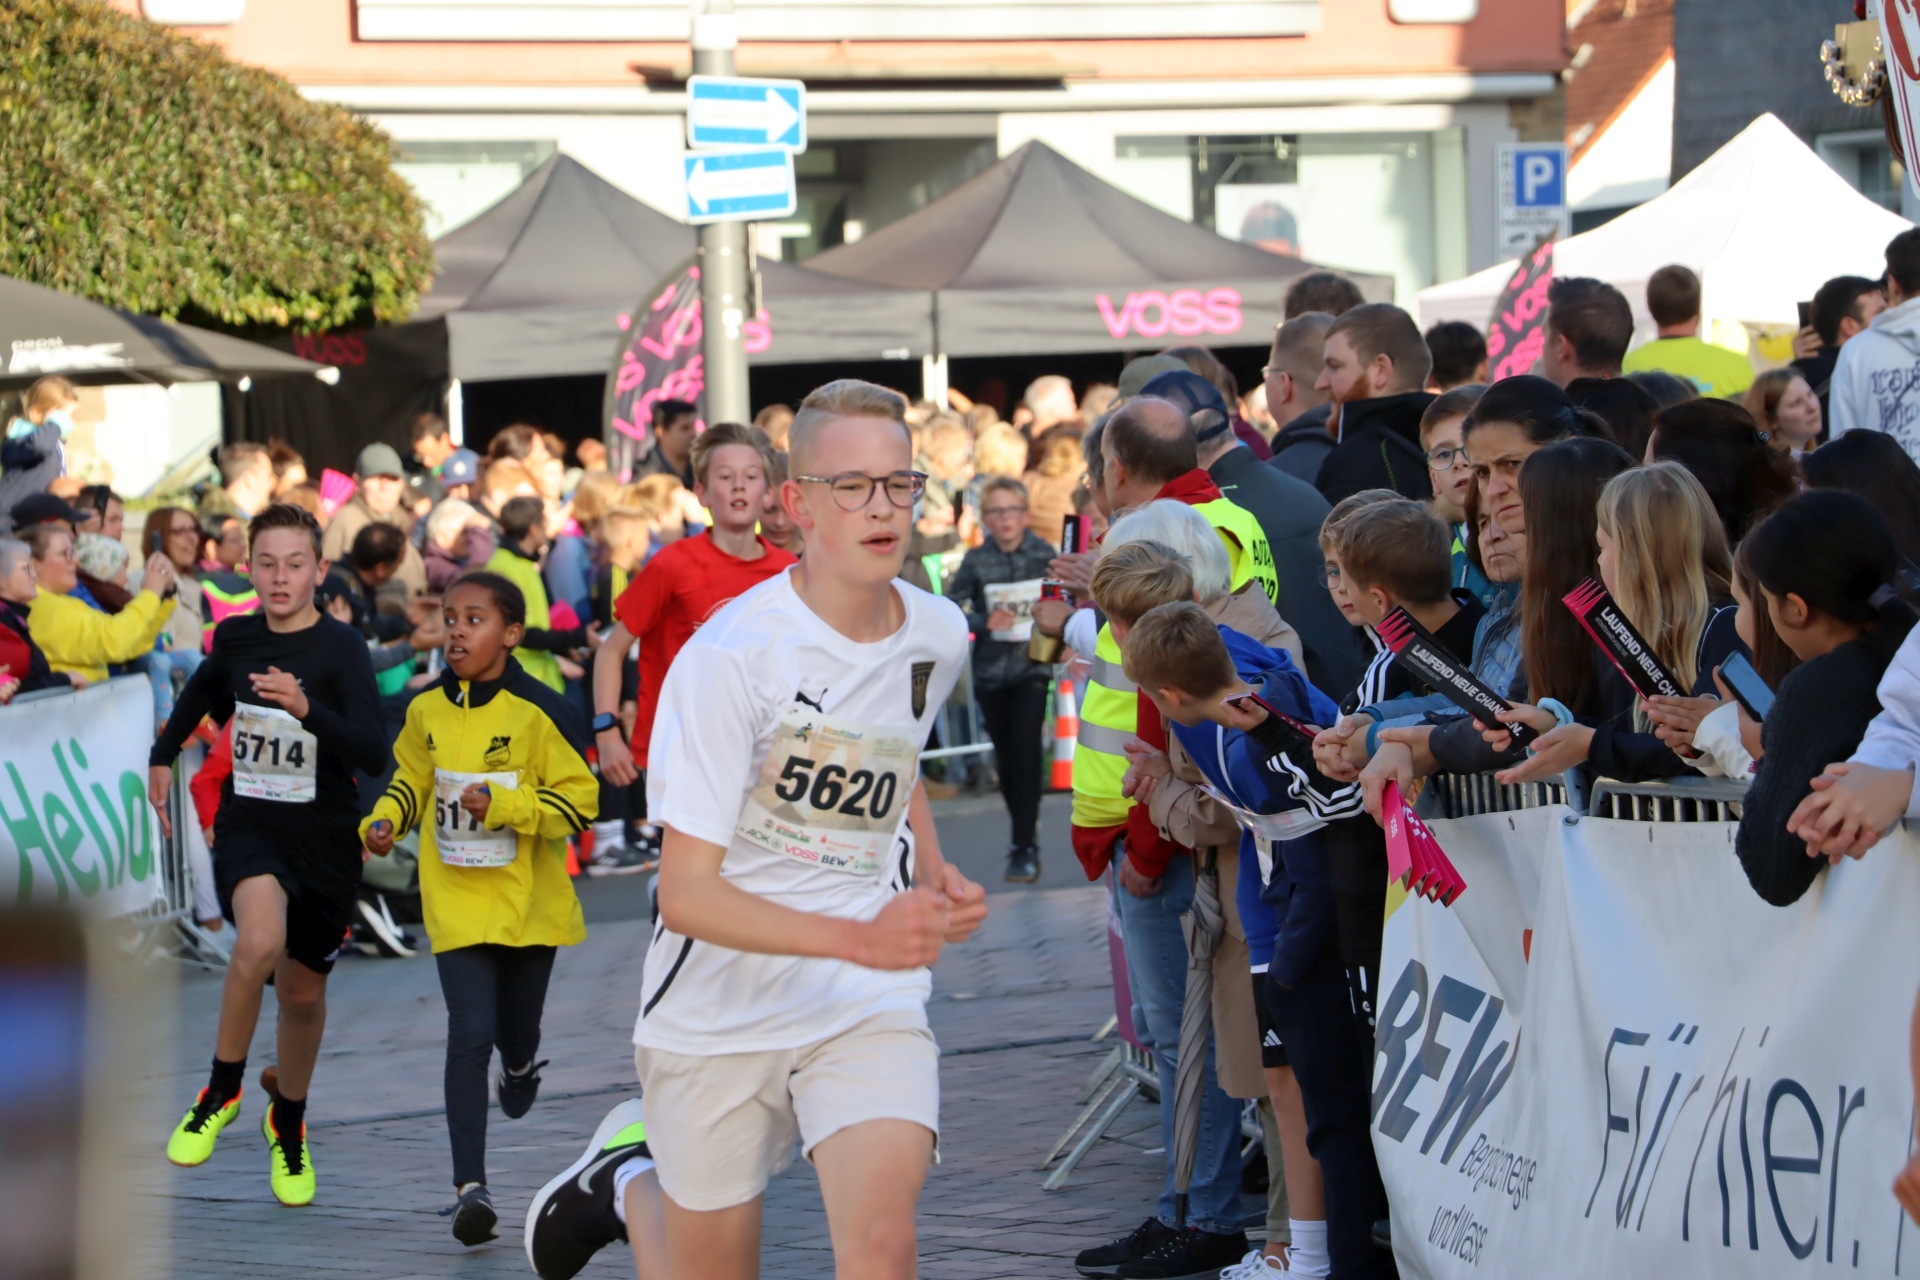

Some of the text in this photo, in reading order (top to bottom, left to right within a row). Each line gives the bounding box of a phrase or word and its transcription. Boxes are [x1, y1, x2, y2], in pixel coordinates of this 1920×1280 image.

[1523, 156, 1554, 203] P
[1095, 288, 1243, 338] VOSS
[1410, 644, 1455, 679] LAUFEND
[1451, 674, 1475, 697] NEUE
[1600, 606, 1641, 655] LAUFEND
[1636, 652, 1663, 682] NEUE
[233, 730, 305, 768] 5714
[775, 755, 897, 819] 5620
[0, 736, 155, 903] Helio
[747, 828, 770, 844] AOK
[785, 843, 820, 861] VOSS
[821, 854, 848, 867] BEW
[1371, 958, 1521, 1165] BEW
[1585, 1023, 1704, 1231] Für
